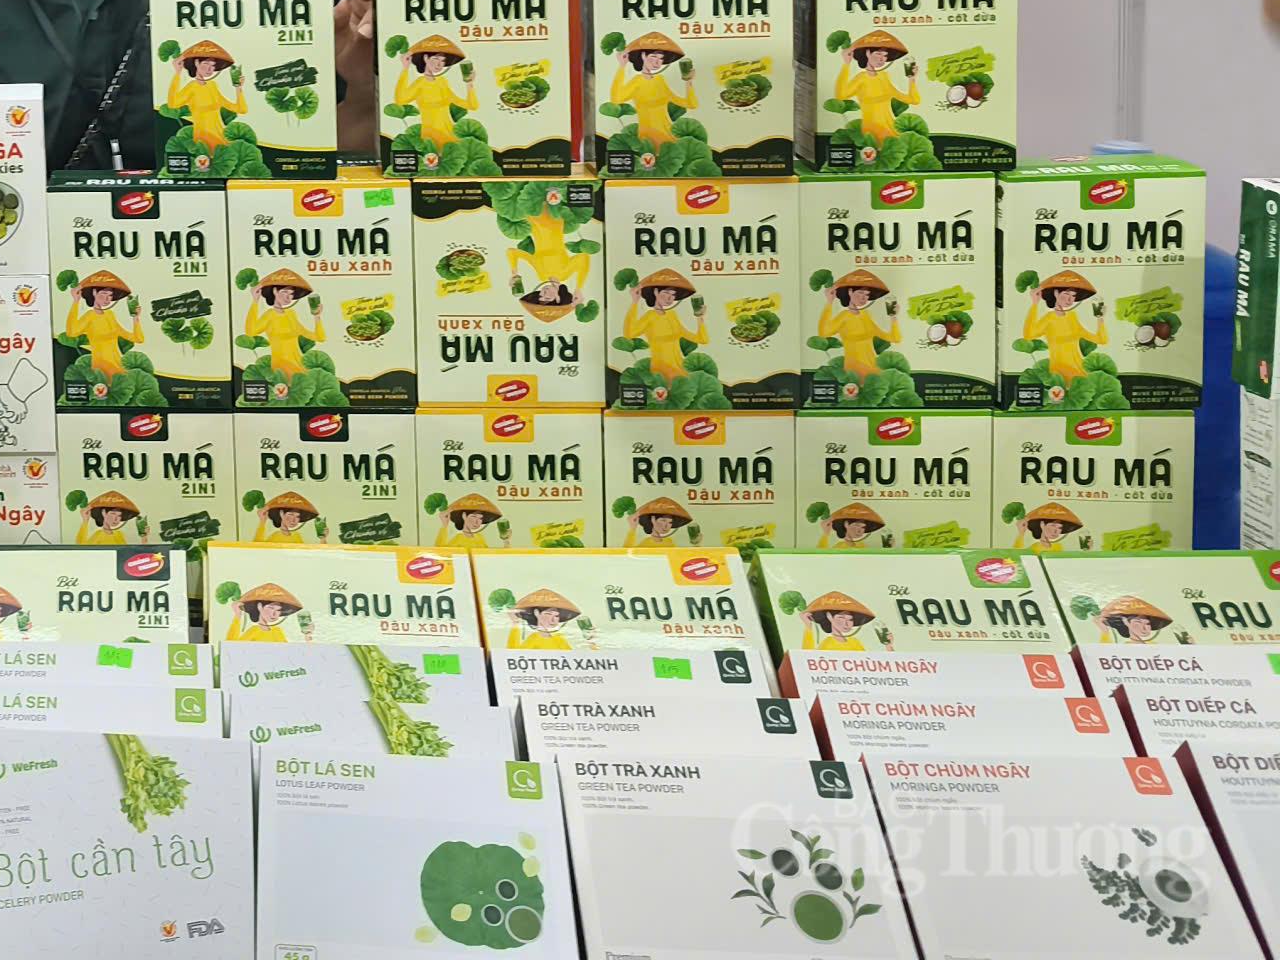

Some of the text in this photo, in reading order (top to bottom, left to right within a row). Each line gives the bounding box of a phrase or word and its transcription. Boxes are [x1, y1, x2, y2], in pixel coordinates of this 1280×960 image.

[176, 0, 242, 28] RAU
[278, 31, 313, 42] 2IN1
[460, 24, 548, 40] Đậu xanh
[74, 221, 205, 258] RAU MÁ
[254, 218, 389, 255] RAU MÁ
[634, 214, 776, 255] RAU MÁ
[828, 210, 972, 251] RAU MÁ
[1034, 210, 1183, 252] RAU MÁ
[173, 262, 208, 273] 2IN1
[691, 258, 779, 274] Đậu xanh
[441, 335, 579, 372] RAU MÁ
[83, 443, 213, 480] RAU MÁ
[443, 444, 580, 481] RAU MÁ
[825, 448, 969, 485] RAU MÁ
[182, 484, 215, 494] 2IN1
[539, 486, 583, 497] xanh
[58, 584, 169, 612] RAU MÁ
[330, 588, 455, 619] RAU MÁ
[138, 616, 169, 625] 2IN1
[507, 656, 618, 672] BỘT TRÀ XANH
[807, 657, 938, 673] BỘT CHÙM NGÂY
[1099, 654, 1202, 673] BỘT DIẾP CÁ
[510, 676, 604, 684] GREEN TEA POWDER
[811, 676, 909, 687] MORINGA POWDER
[11, 758, 58, 773] WeFresh
[276, 758, 375, 778] BỘT LÁ SEN
[276, 780, 365, 791] LOTUS LEAF POWDER
[71, 838, 135, 879] cần
[153, 834, 214, 880] tây
[39, 890, 84, 905] POWDER
